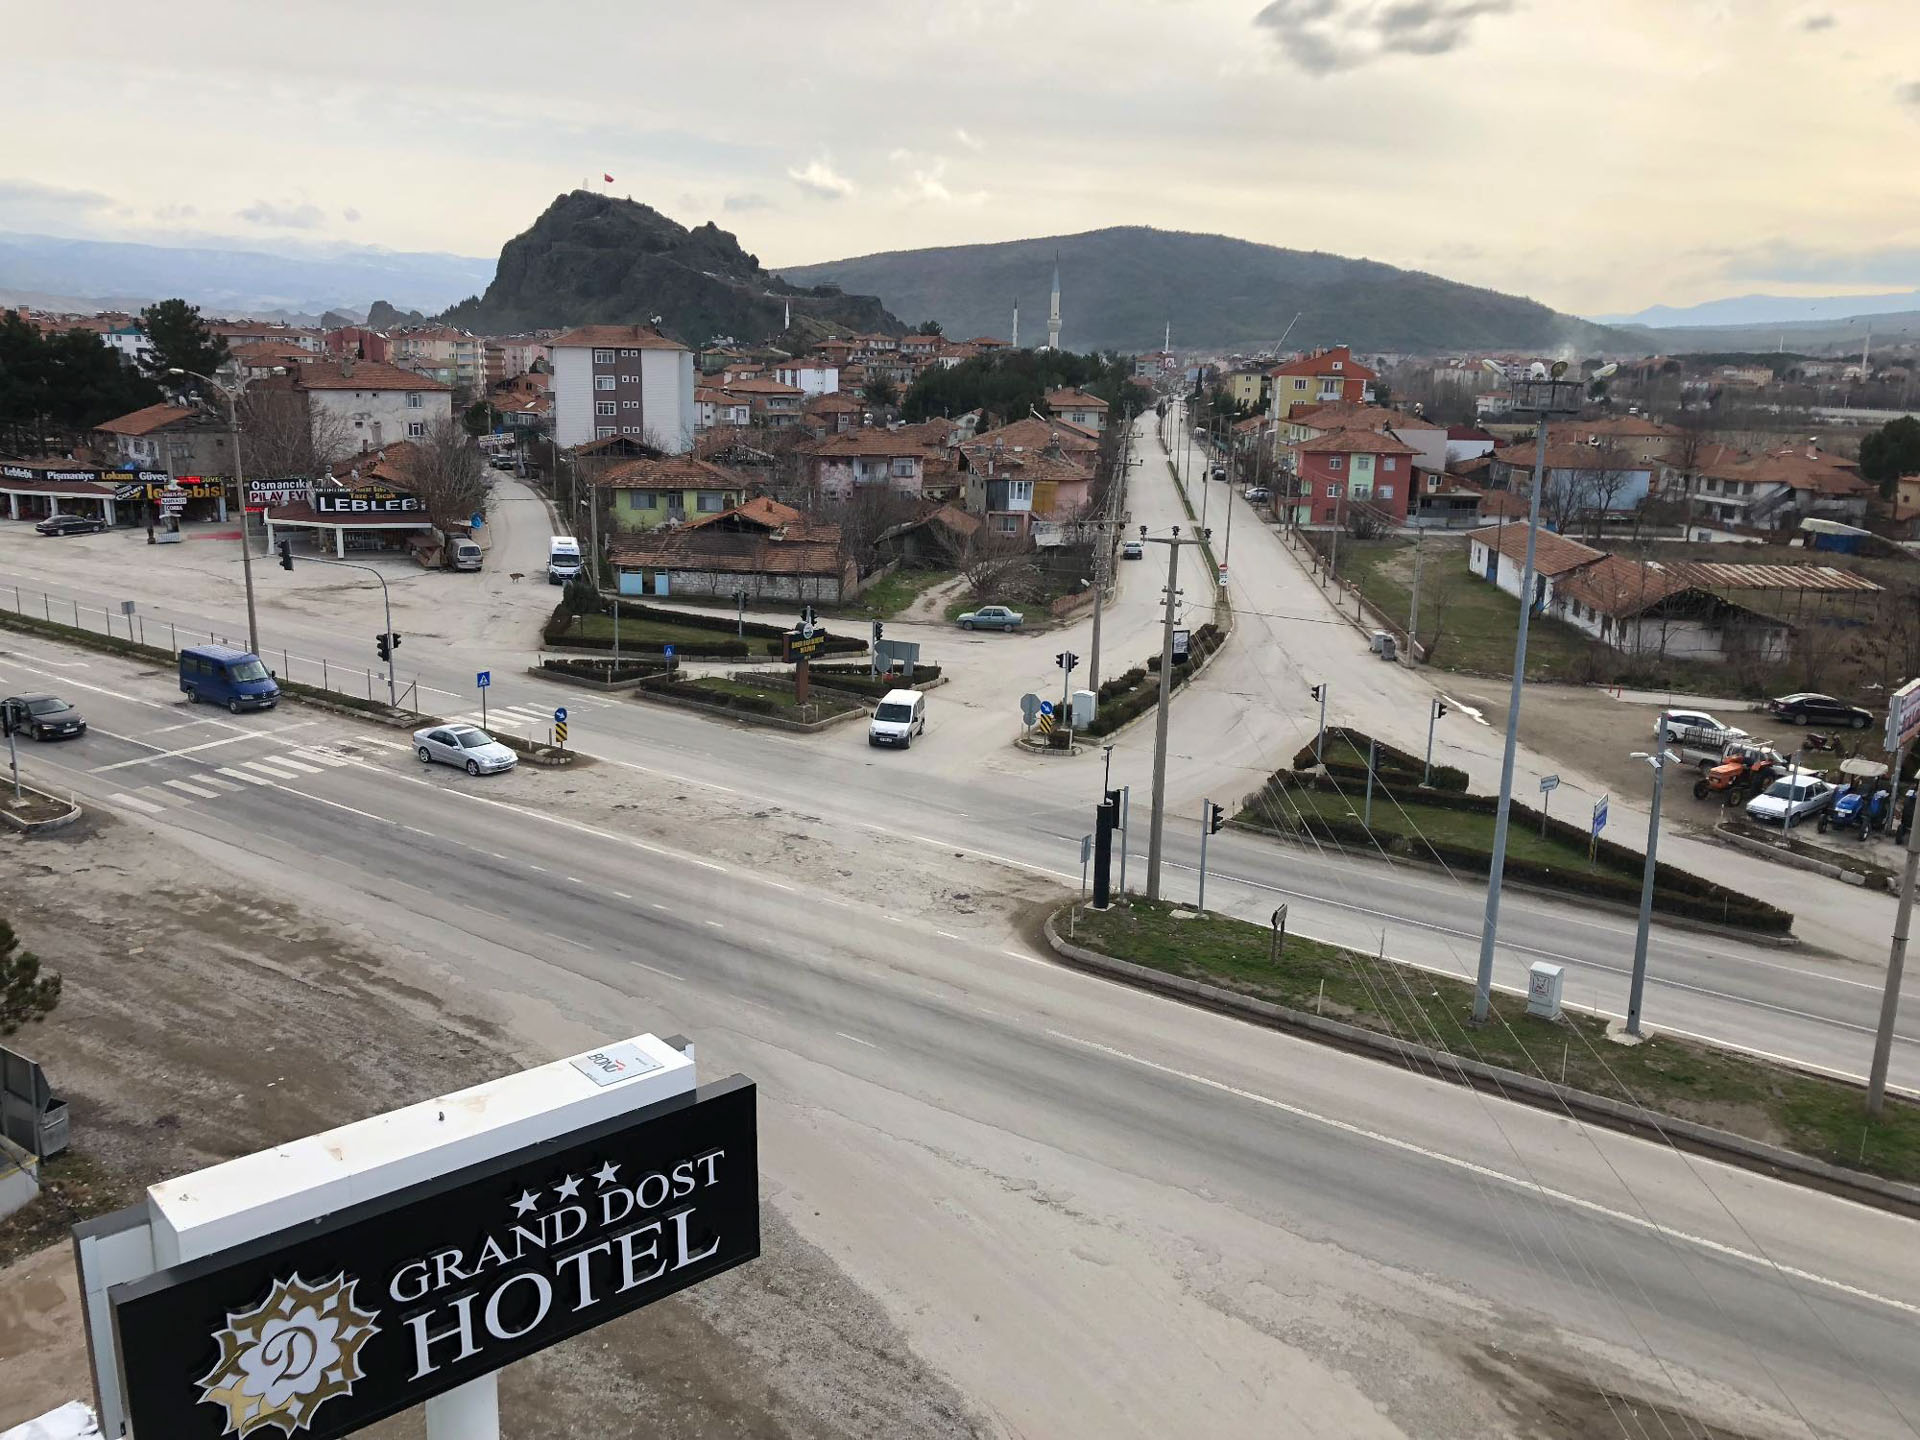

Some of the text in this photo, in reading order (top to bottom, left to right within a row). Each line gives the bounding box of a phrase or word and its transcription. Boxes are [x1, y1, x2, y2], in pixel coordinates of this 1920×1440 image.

[47, 471, 94, 481] Pişmaniye
[101, 471, 133, 480] Lokum
[139, 471, 168, 482] Güveç
[389, 1150, 725, 1302] GRAND DOST
[403, 1207, 721, 1382] HOTEL
